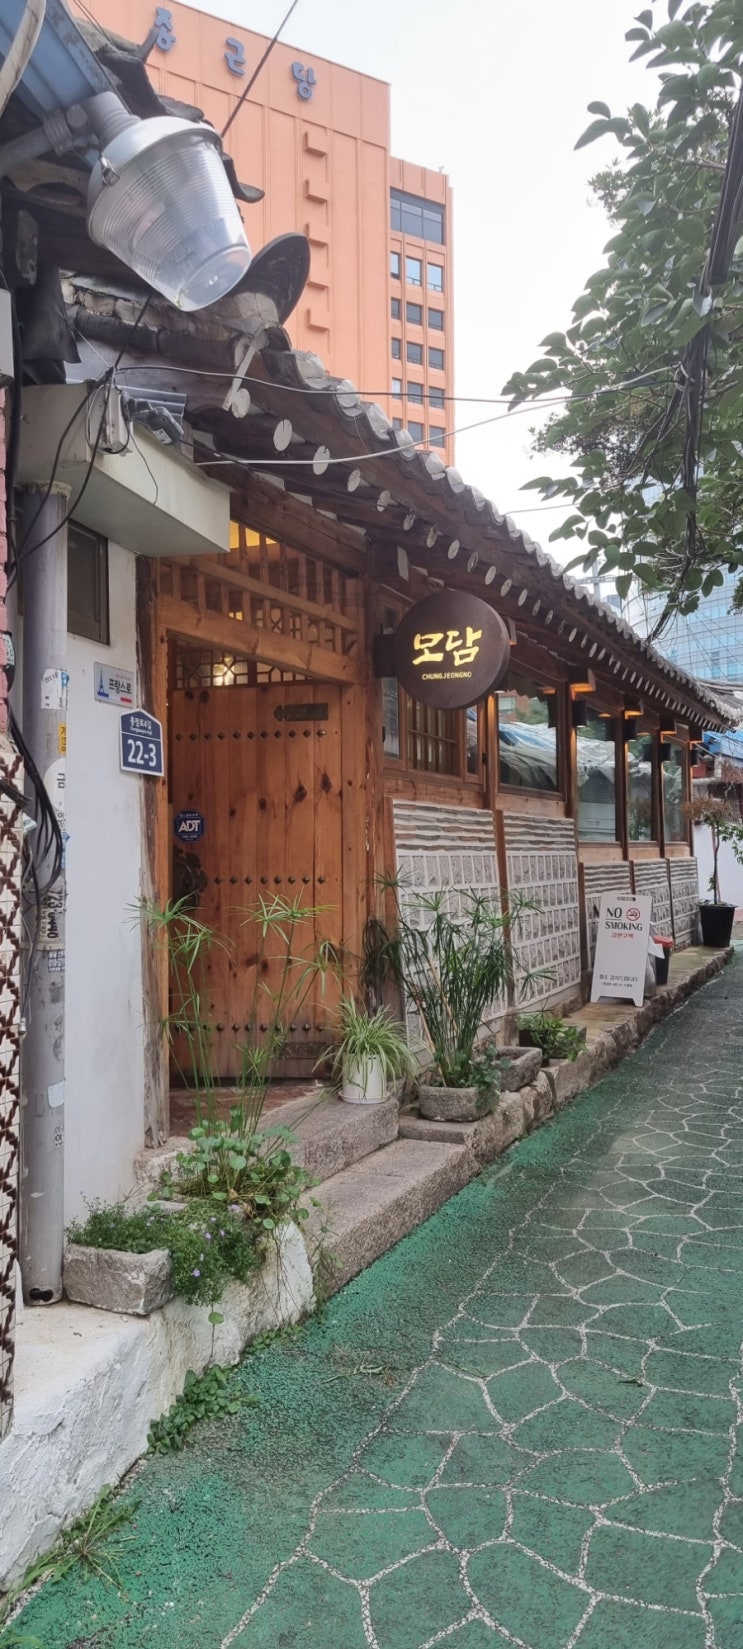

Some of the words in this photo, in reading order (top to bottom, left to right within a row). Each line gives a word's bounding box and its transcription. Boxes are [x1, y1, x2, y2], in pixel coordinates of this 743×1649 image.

[155, 7, 317, 100] 종근당
[412, 626, 482, 667] 모담
[422, 671, 472, 681] CHUNGJEONGNO
[109, 678, 132, 694] 프랑스로
[127, 739, 157, 767] 22-3
[178, 820, 201, 832] ADT
[606, 907, 622, 919] NO
[605, 921, 643, 931] SMOKING
